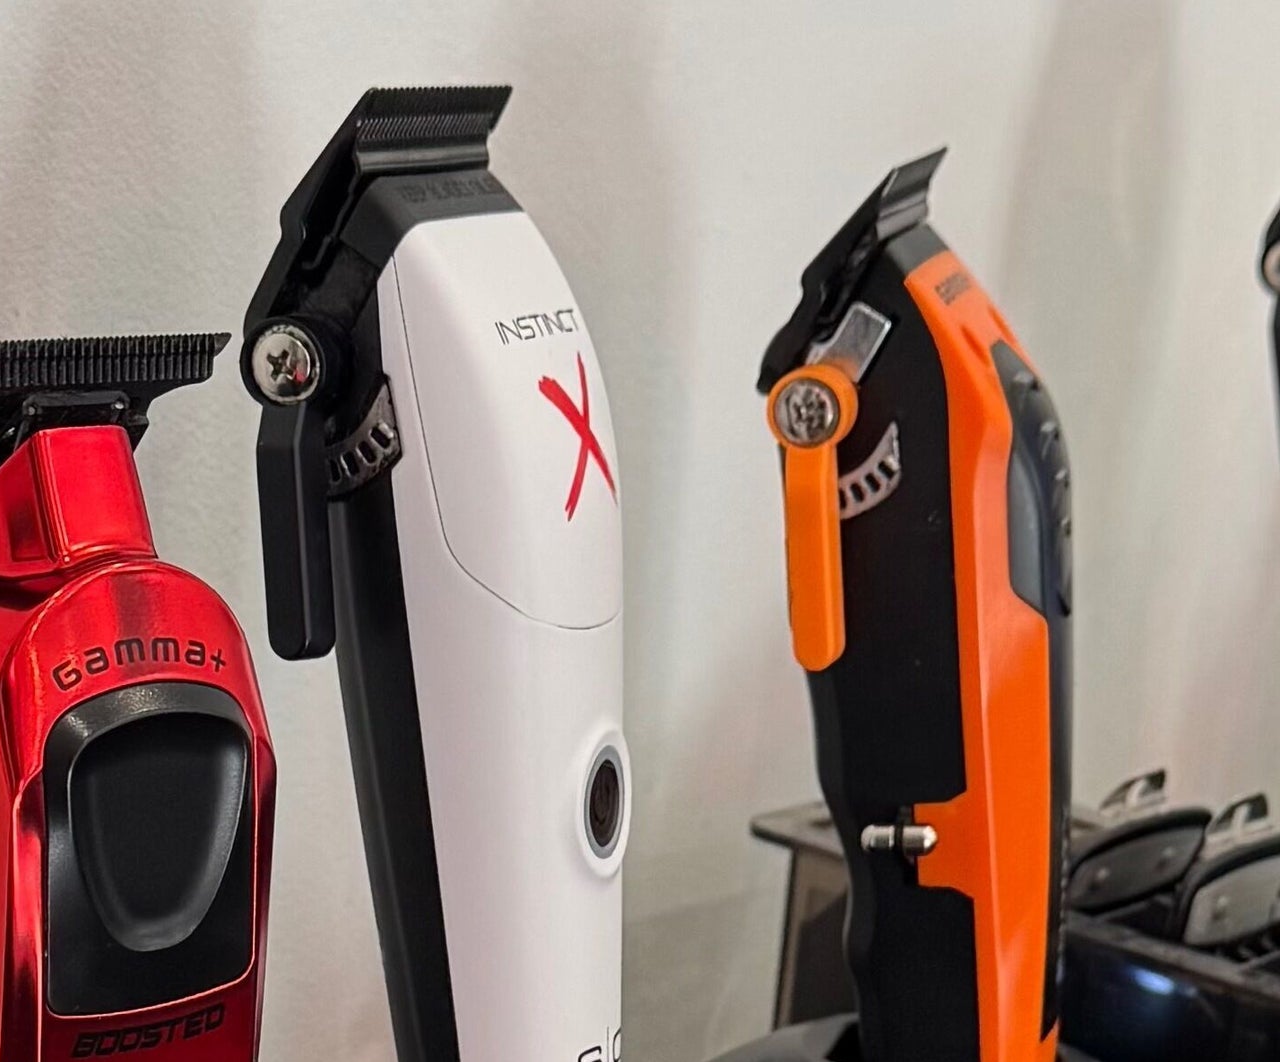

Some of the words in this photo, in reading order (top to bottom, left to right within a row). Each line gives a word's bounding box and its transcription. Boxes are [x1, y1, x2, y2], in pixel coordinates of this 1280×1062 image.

[495, 308, 579, 345] INSTINCT
[538, 351, 618, 522] X
[52, 636, 227, 691] Gamma+
[71, 1004, 226, 1059] BOOSTED
